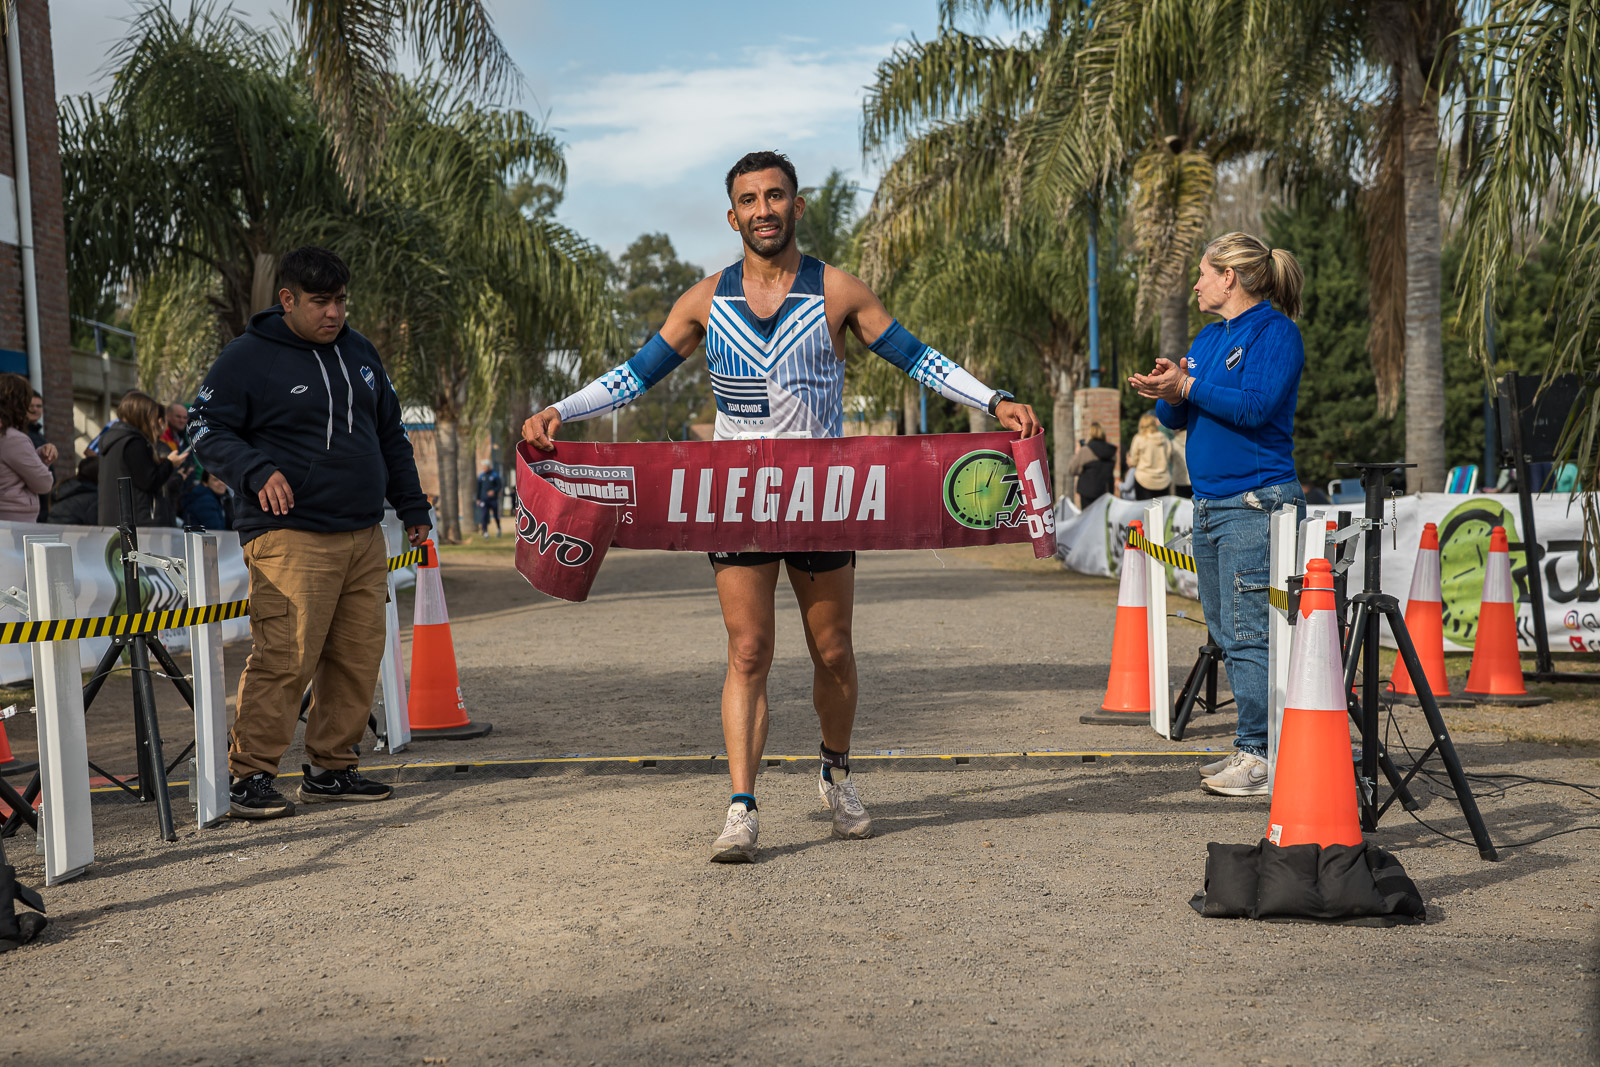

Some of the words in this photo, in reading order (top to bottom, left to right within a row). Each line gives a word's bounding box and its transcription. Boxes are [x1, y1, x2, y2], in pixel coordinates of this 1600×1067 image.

[727, 402, 740, 413] TEAM
[740, 404, 762, 413] CONDE
[554, 464, 628, 479] ASEGURADOR
[667, 464, 886, 523] LLEGADA
